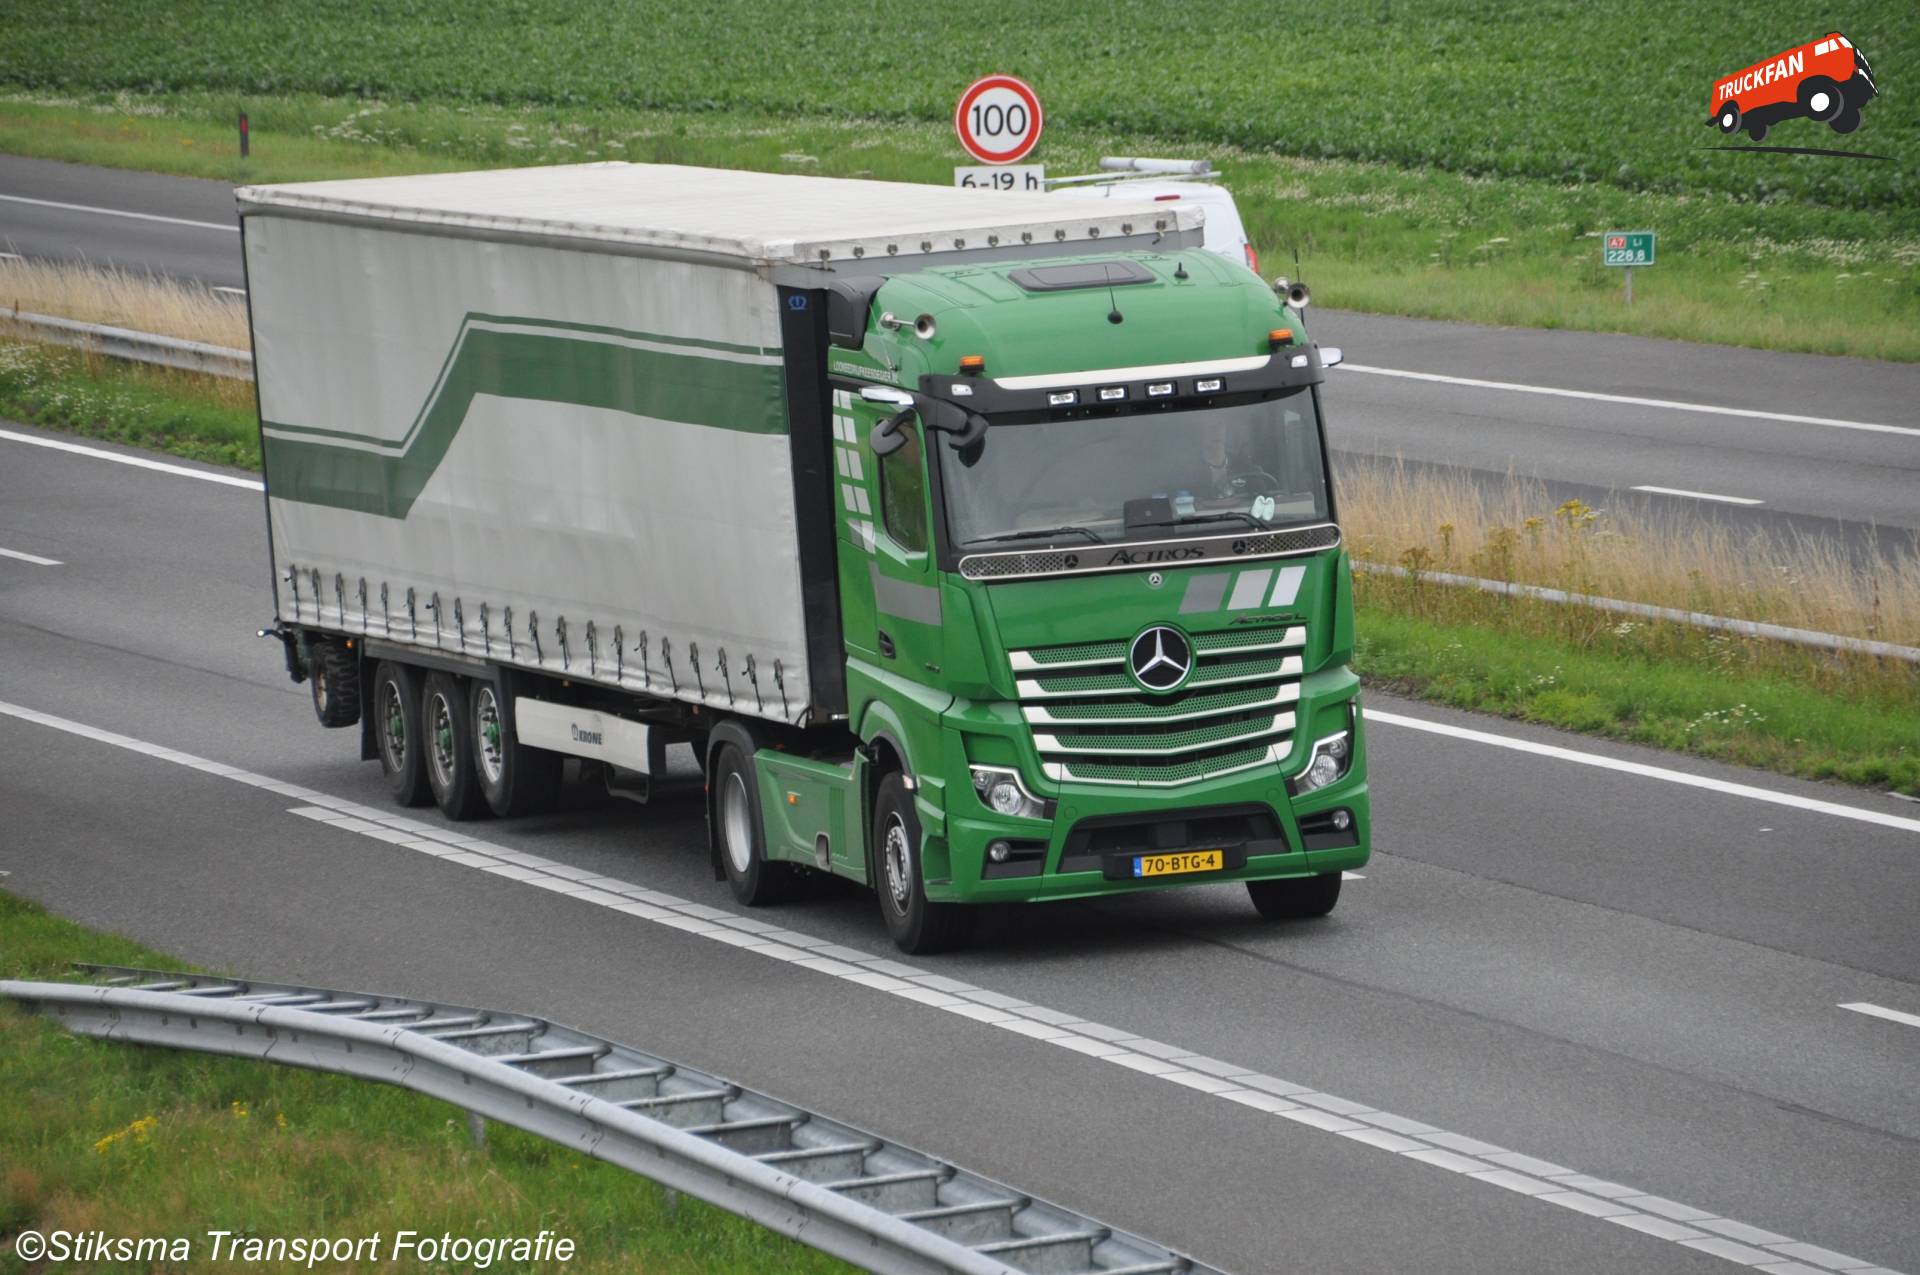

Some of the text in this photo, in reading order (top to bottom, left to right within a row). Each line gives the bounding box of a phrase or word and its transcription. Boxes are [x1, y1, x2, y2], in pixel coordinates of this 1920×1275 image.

[972, 104, 1027, 137] 100
[1025, 171, 1038, 190] h
[1610, 237, 1625, 248] A7
[579, 730, 602, 745] KRONE
[1145, 854, 1215, 873] 70-BTG-4
